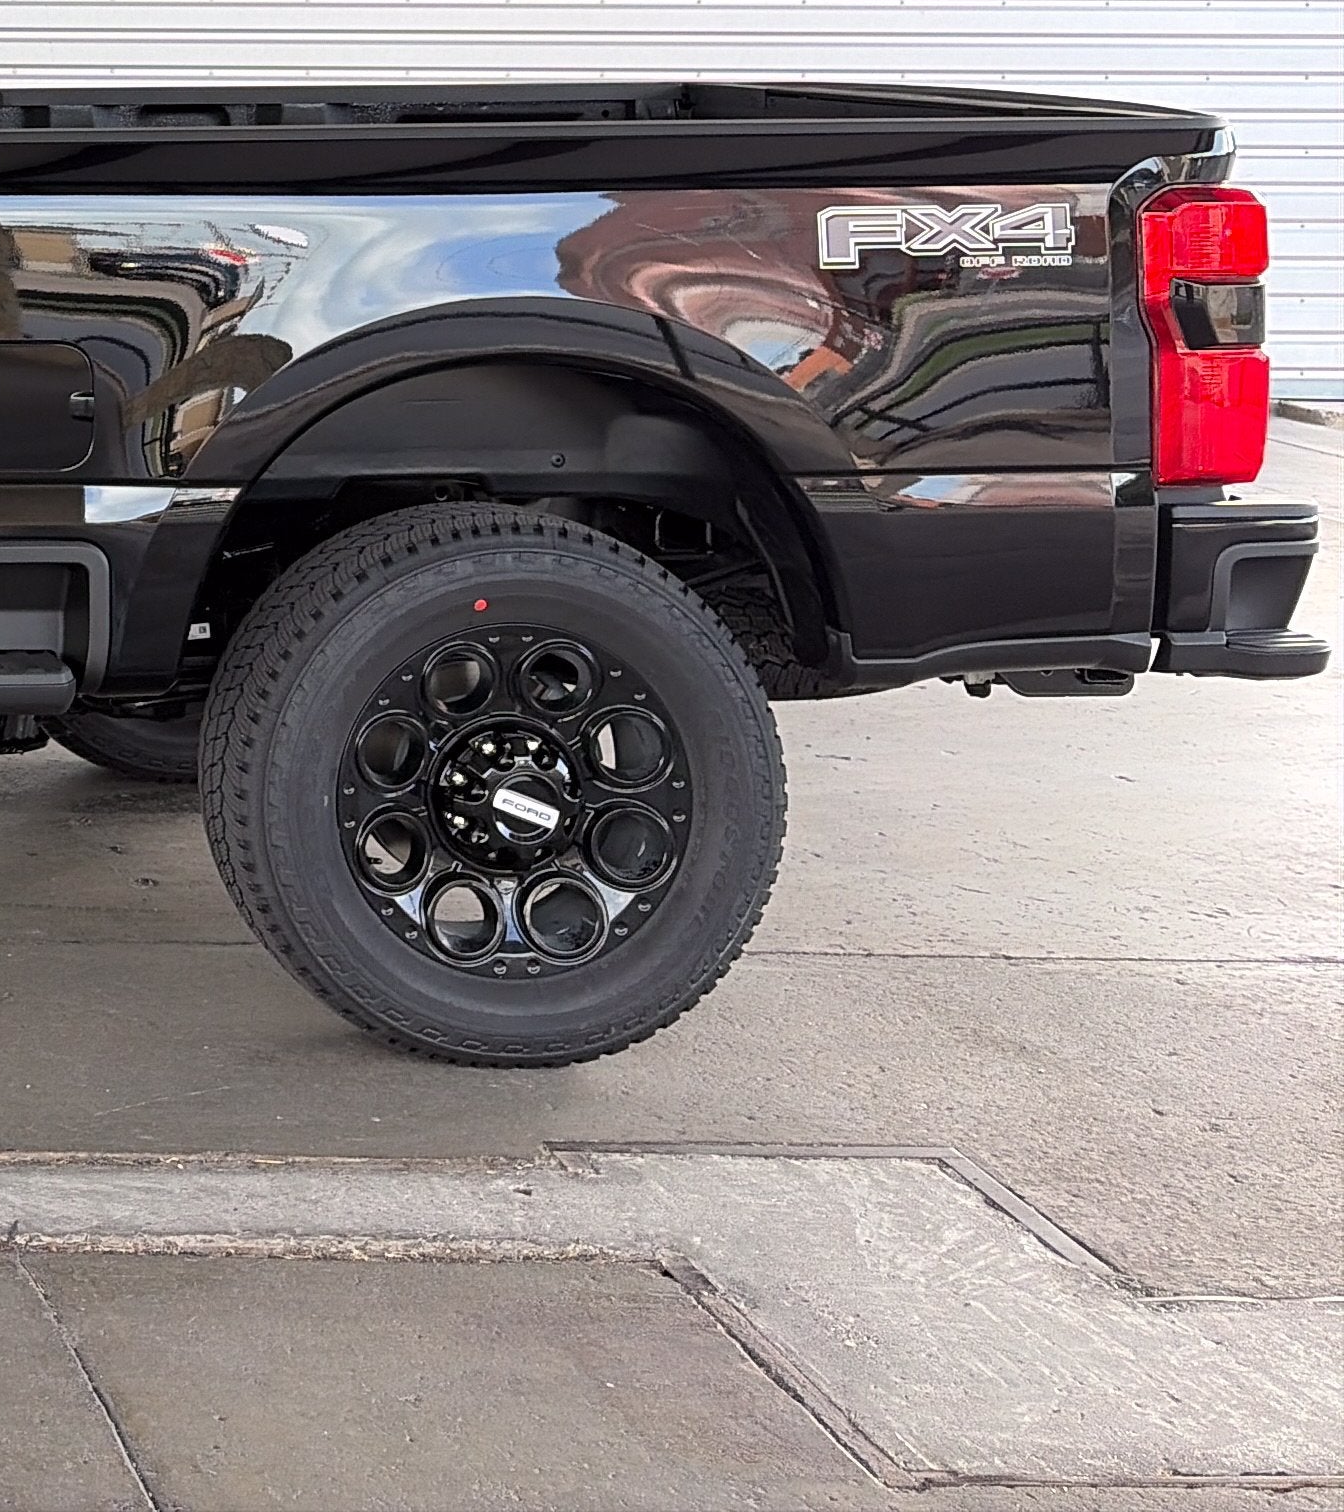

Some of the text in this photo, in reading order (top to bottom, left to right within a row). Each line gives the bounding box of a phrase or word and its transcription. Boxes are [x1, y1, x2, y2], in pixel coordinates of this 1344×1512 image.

[817, 203, 1074, 269] FX4
[960, 255, 1072, 268] OFF ROAD
[501, 798, 552, 822] FORD
